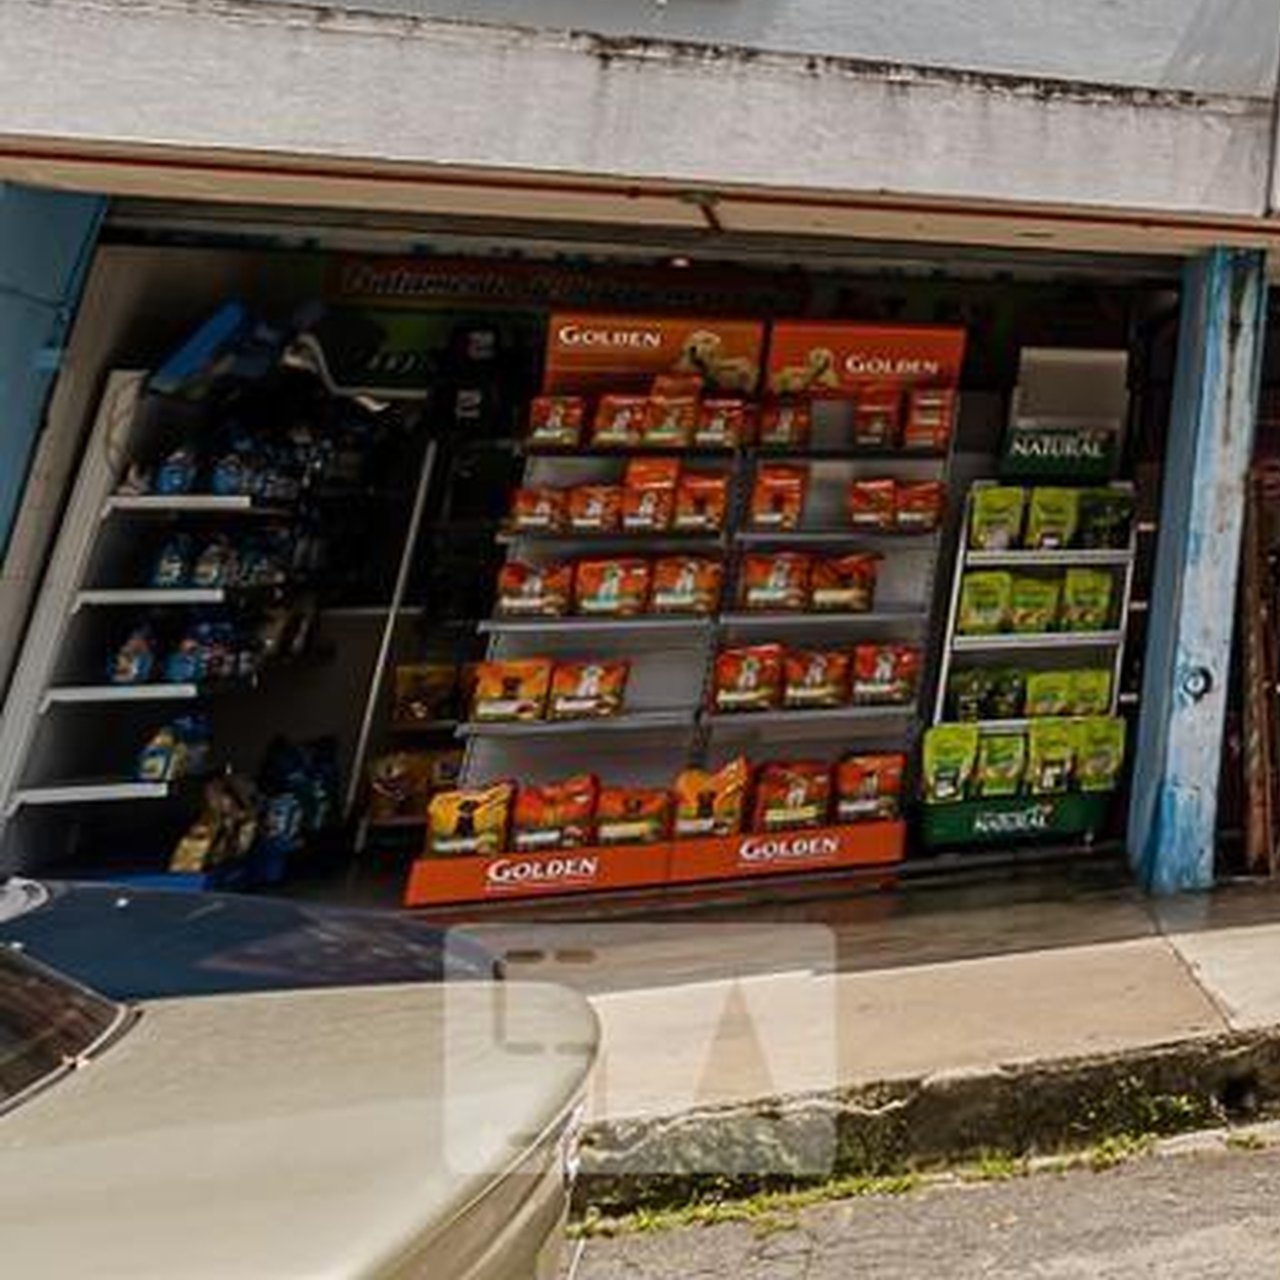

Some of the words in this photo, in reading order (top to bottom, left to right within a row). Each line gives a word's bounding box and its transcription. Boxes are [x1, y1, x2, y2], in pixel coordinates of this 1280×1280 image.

[558, 325, 661, 348] GOLDEN
[844, 354, 940, 375] GOLDEN
[1009, 436, 1104, 458] NATURAL
[738, 836, 840, 860] GOLDEN
[486, 857, 599, 883] GOLDEN
